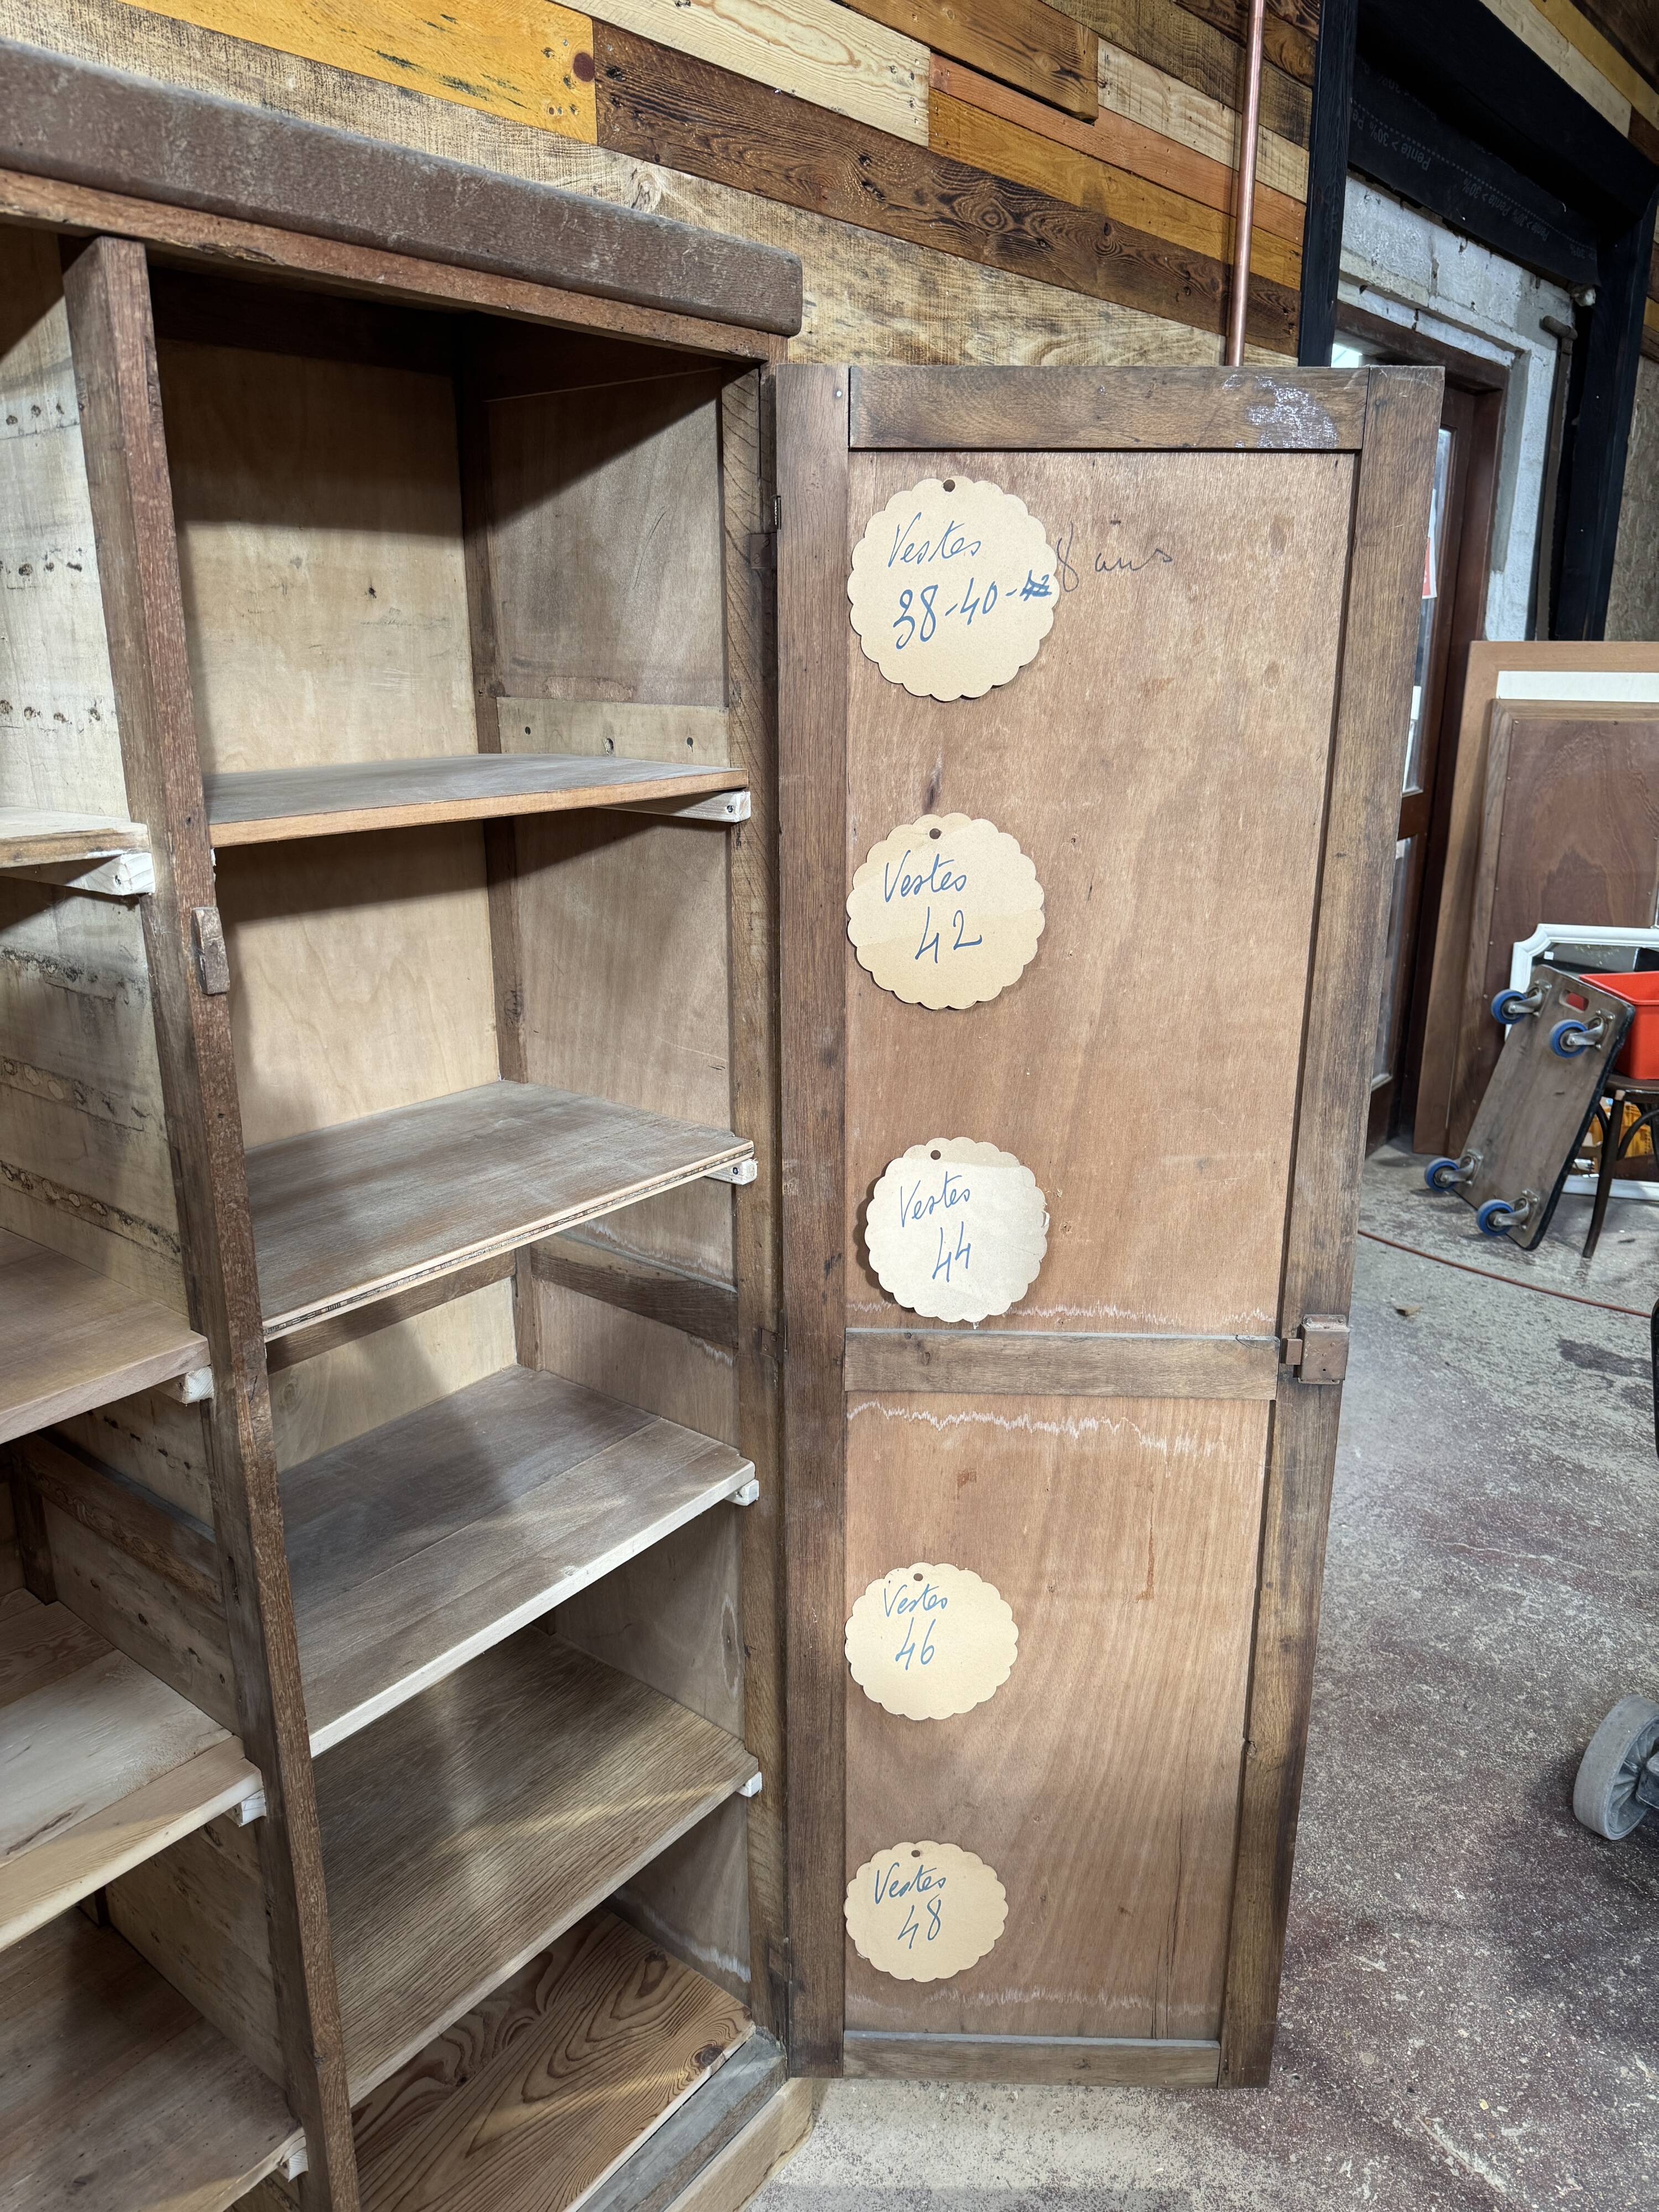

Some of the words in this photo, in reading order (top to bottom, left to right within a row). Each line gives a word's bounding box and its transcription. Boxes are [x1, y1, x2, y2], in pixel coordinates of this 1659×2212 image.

[1370, 121, 1389, 147] 30%
[1401, 143, 1431, 171] Pente
[888, 512, 982, 567] Vestes
[885, 850, 967, 902] Vestes
[915, 906, 983, 964] 42
[901, 1171, 971, 1228] Vestes
[932, 1221, 971, 1282] 44
[884, 1583, 948, 1617] Vestes
[895, 1616, 936, 1671] 46
[875, 1862, 946, 1904] Vestes
[898, 1894, 941, 1949] 48
